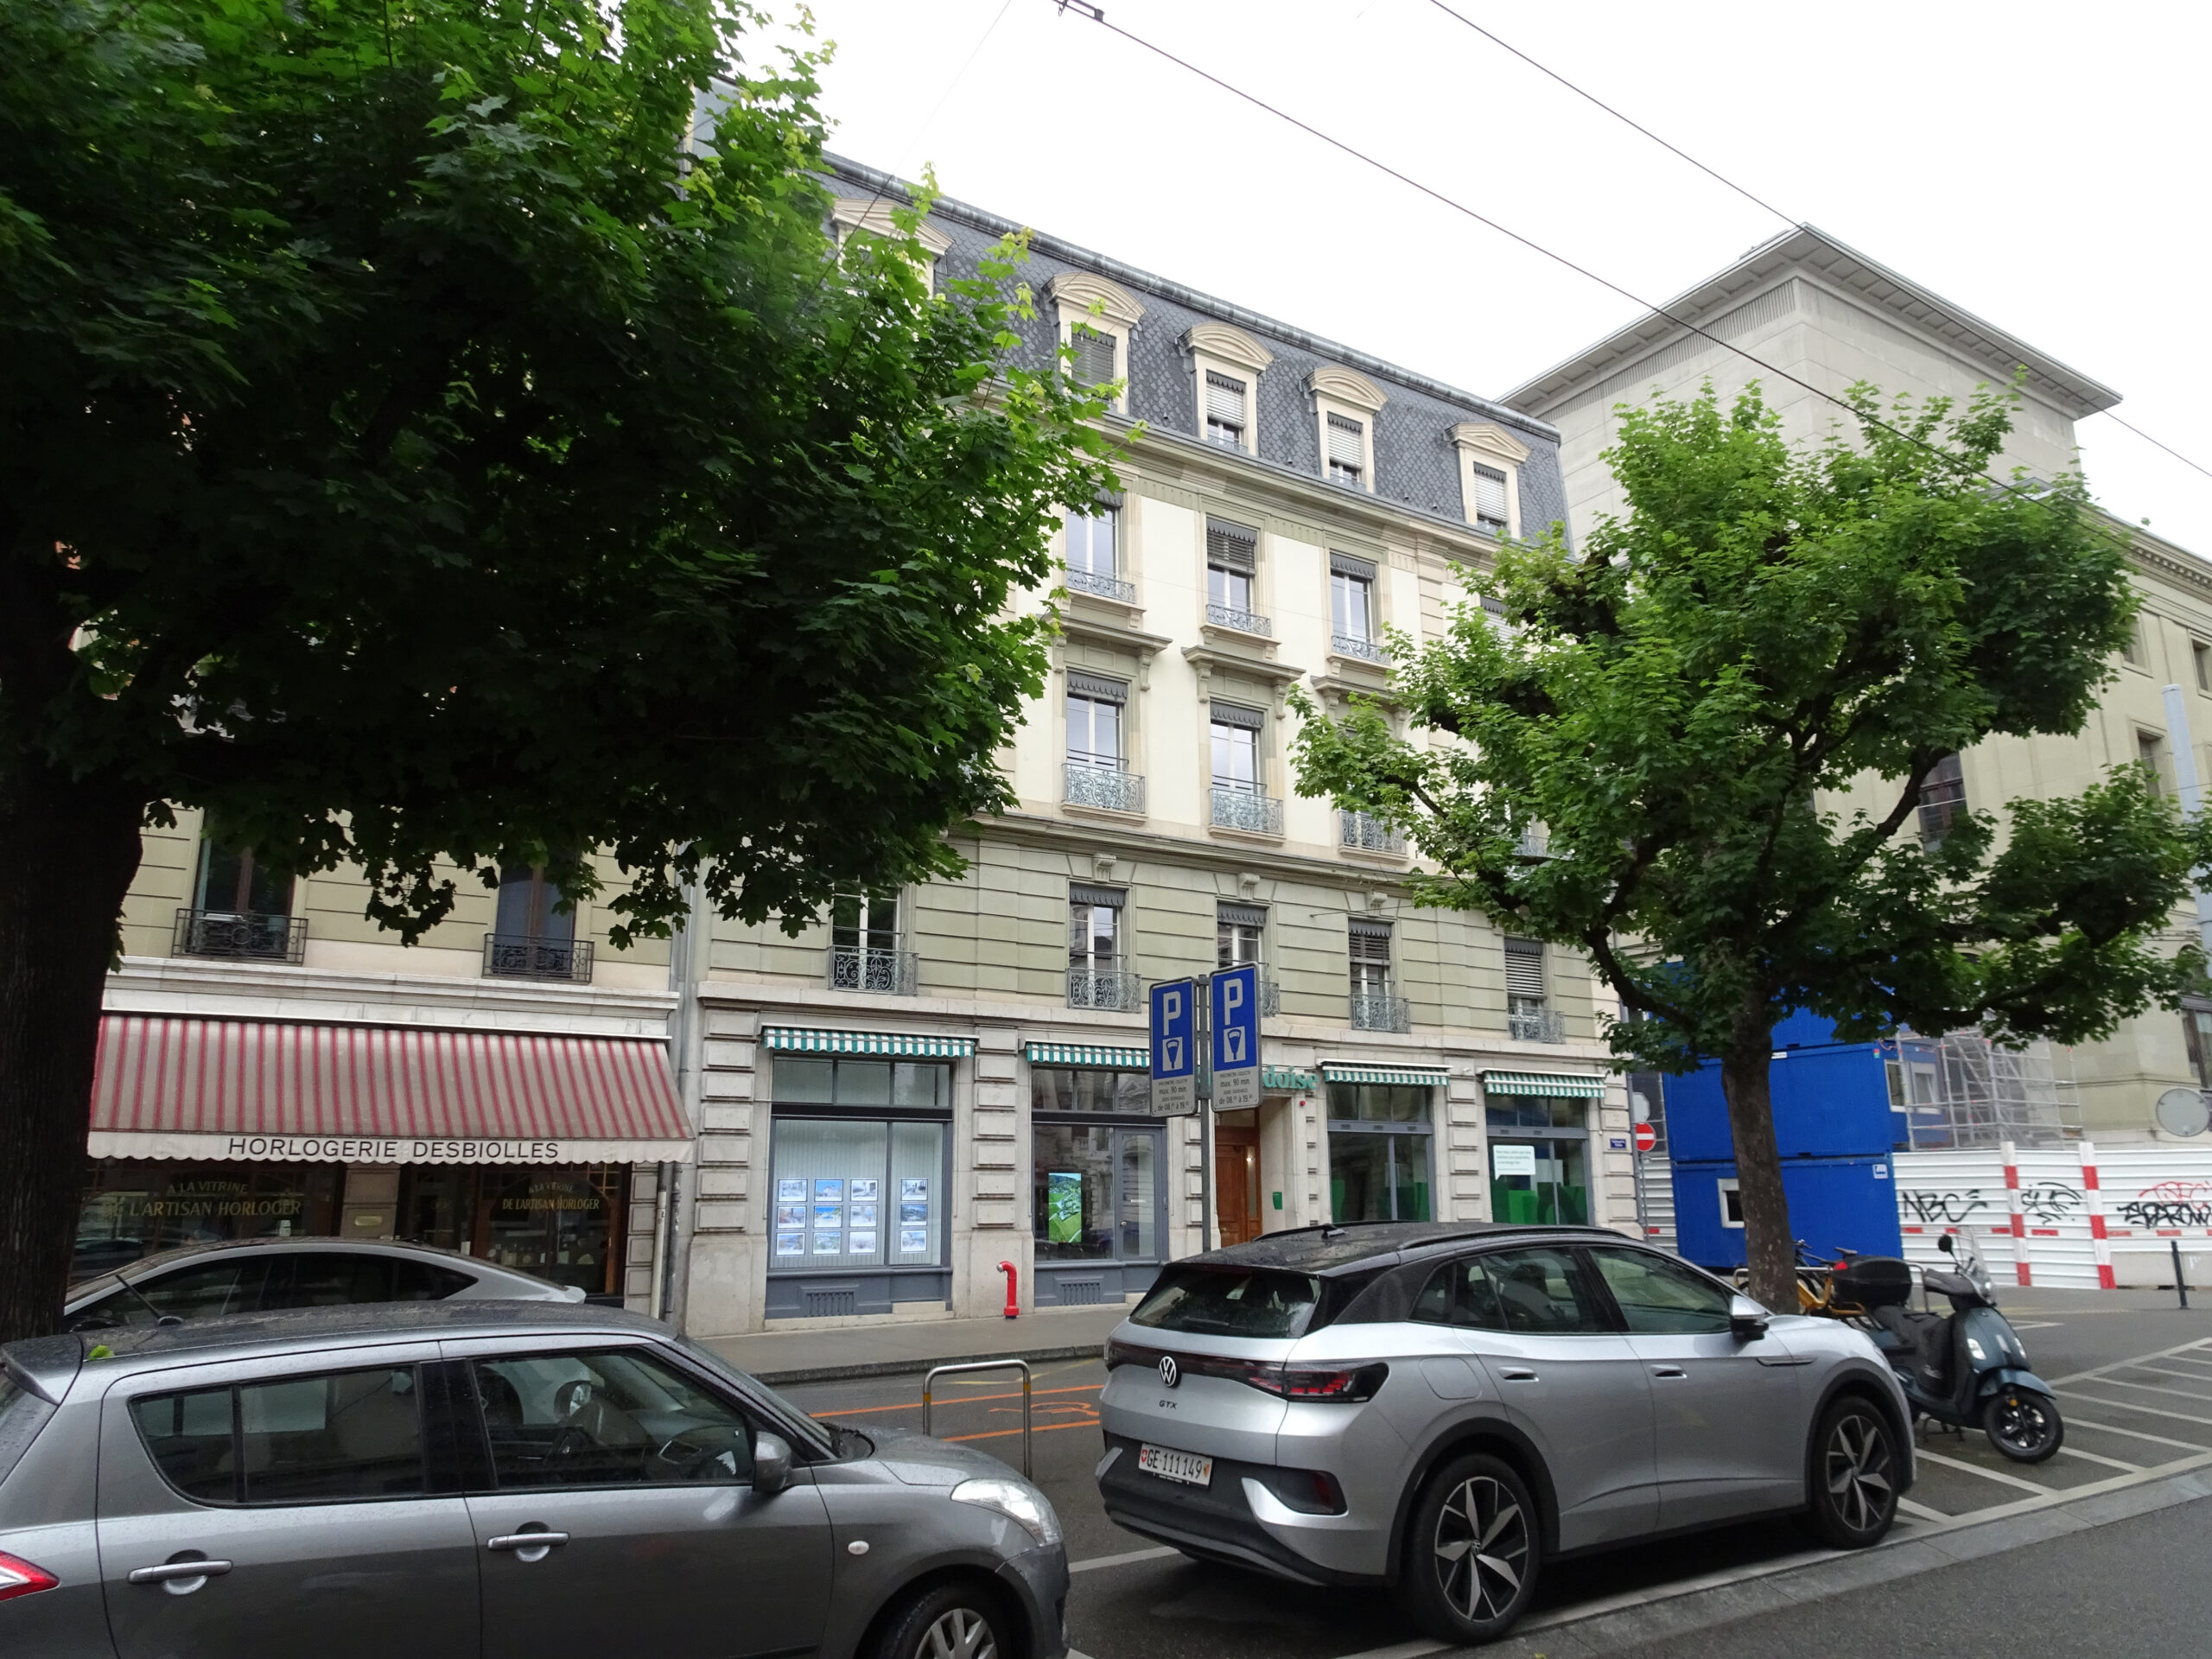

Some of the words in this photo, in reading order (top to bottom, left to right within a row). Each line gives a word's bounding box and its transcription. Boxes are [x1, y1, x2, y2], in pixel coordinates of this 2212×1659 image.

[1223, 978, 1243, 1026] P
[1163, 991, 1181, 1035] P
[228, 1138, 398, 1158] HORLOGERIE
[412, 1141, 559, 1159] DESBIOLLES
[180, 1182, 194, 1192] LA
[198, 1181, 249, 1195] VITRINE
[130, 1200, 213, 1217] L'ARTISAN
[218, 1199, 302, 1217] HORLOGER
[502, 1198, 513, 1211] DE
[556, 1198, 600, 1211] HORLOGER
[1159, 1400, 1178, 1409] GTX
